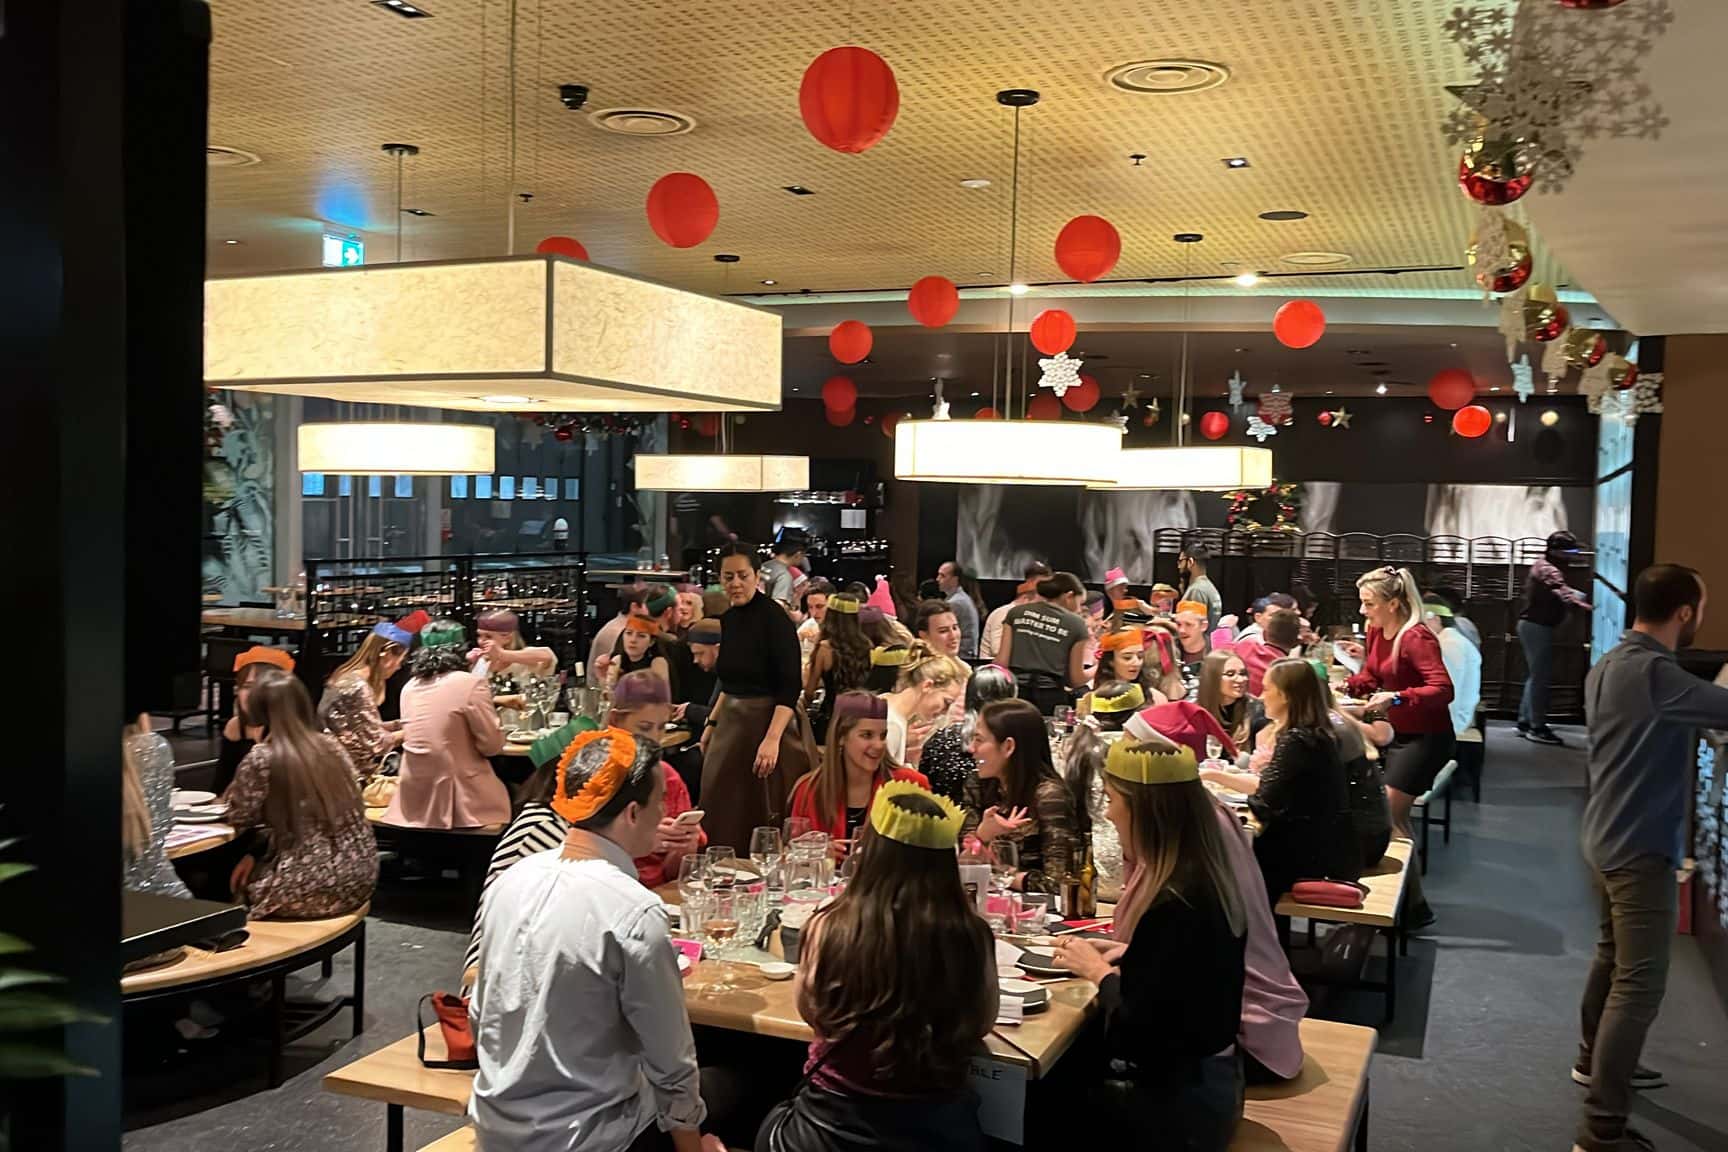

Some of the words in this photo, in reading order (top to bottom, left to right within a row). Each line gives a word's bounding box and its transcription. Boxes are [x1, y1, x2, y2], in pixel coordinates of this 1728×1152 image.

[1041, 615, 1060, 625] SUM
[1045, 624, 1057, 632] TO
[1057, 628, 1069, 636] BE
